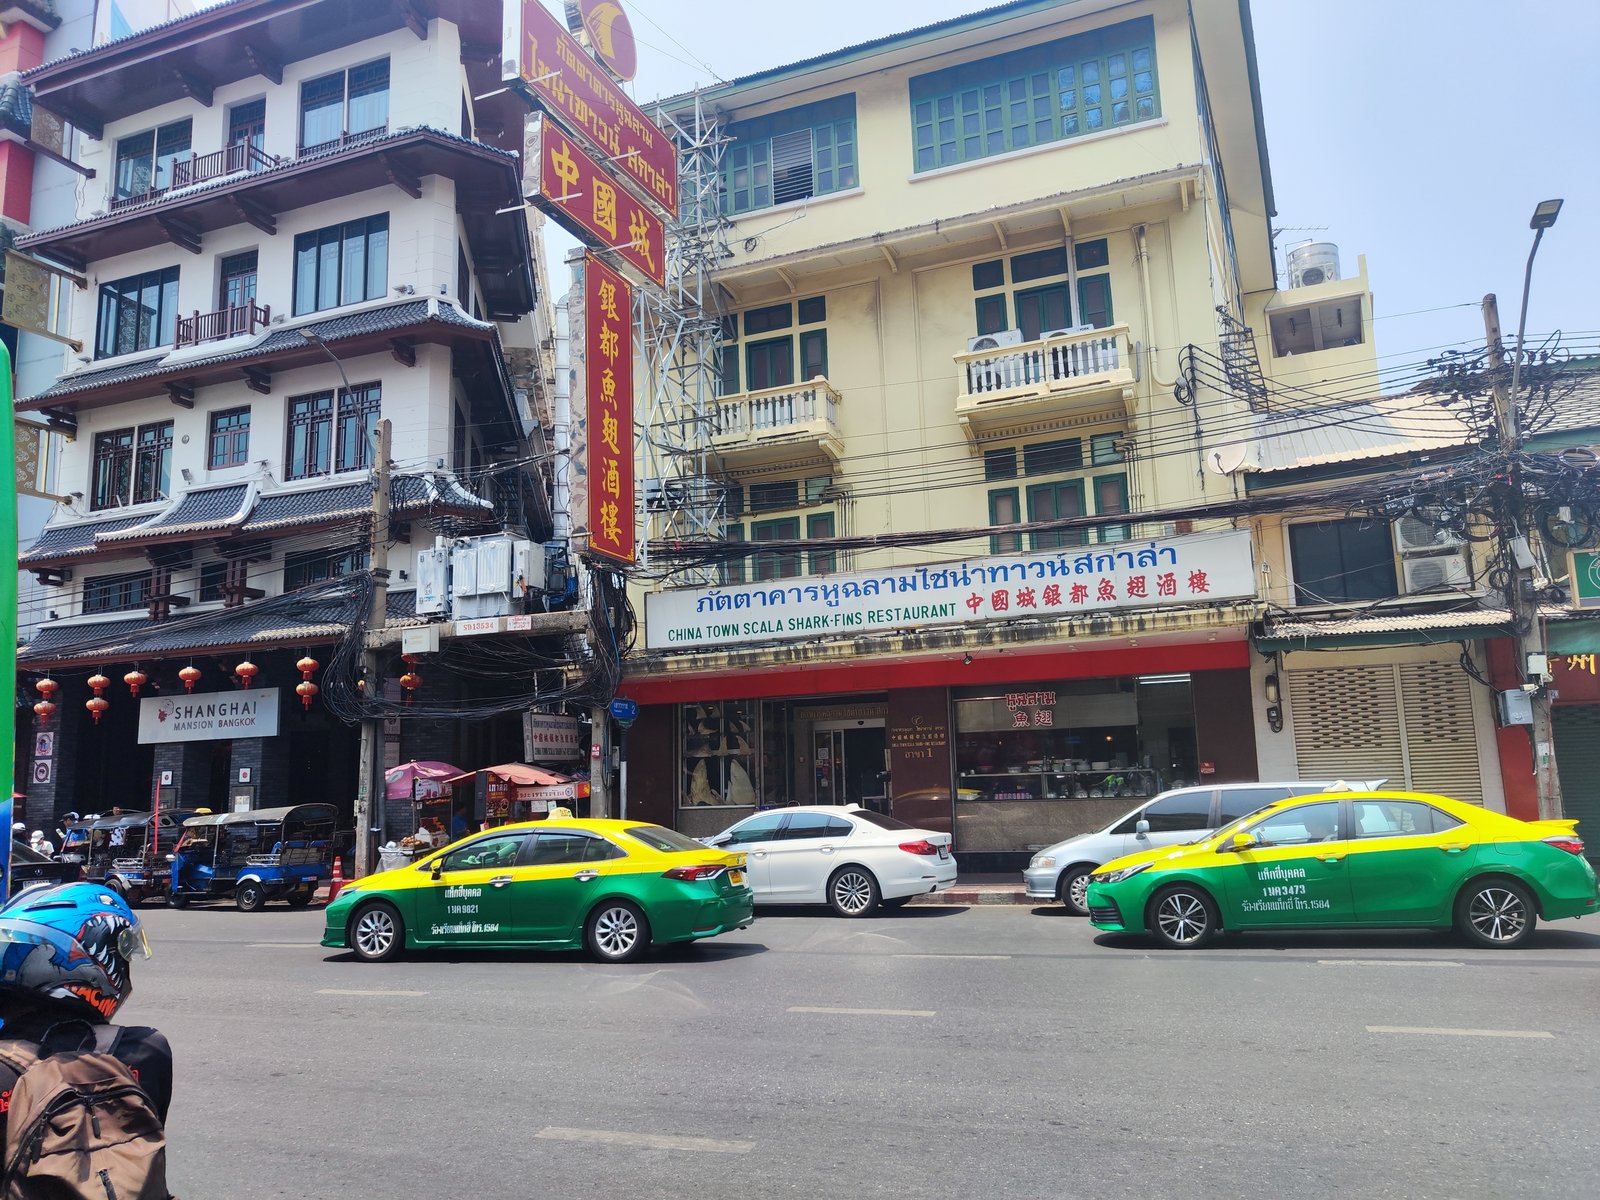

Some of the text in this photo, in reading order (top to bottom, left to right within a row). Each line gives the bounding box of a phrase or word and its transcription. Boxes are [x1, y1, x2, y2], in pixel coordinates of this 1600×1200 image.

[556, 32, 654, 149] ภัตตาคารหูฉลาม
[551, 141, 656, 274] 中國城
[597, 278, 623, 547] 銀都魚翅酒樓
[965, 569, 1210, 615] 中國城銀都魚翅酒樓
[668, 602, 957, 642] CHINA TOWN SCALA SHARK-FINS RESTAURANT
[174, 701, 257, 720] SHANGHAI
[631, 705, 636, 715] 2
[1005, 691, 1057, 711] หูฉลาม
[173, 717, 256, 731] MANSION BANGKOK
[1012, 709, 1053, 727] 魚翅
[927, 748, 933, 758] 1
[1258, 865, 1306, 881] แท็กซี่บุคคล
